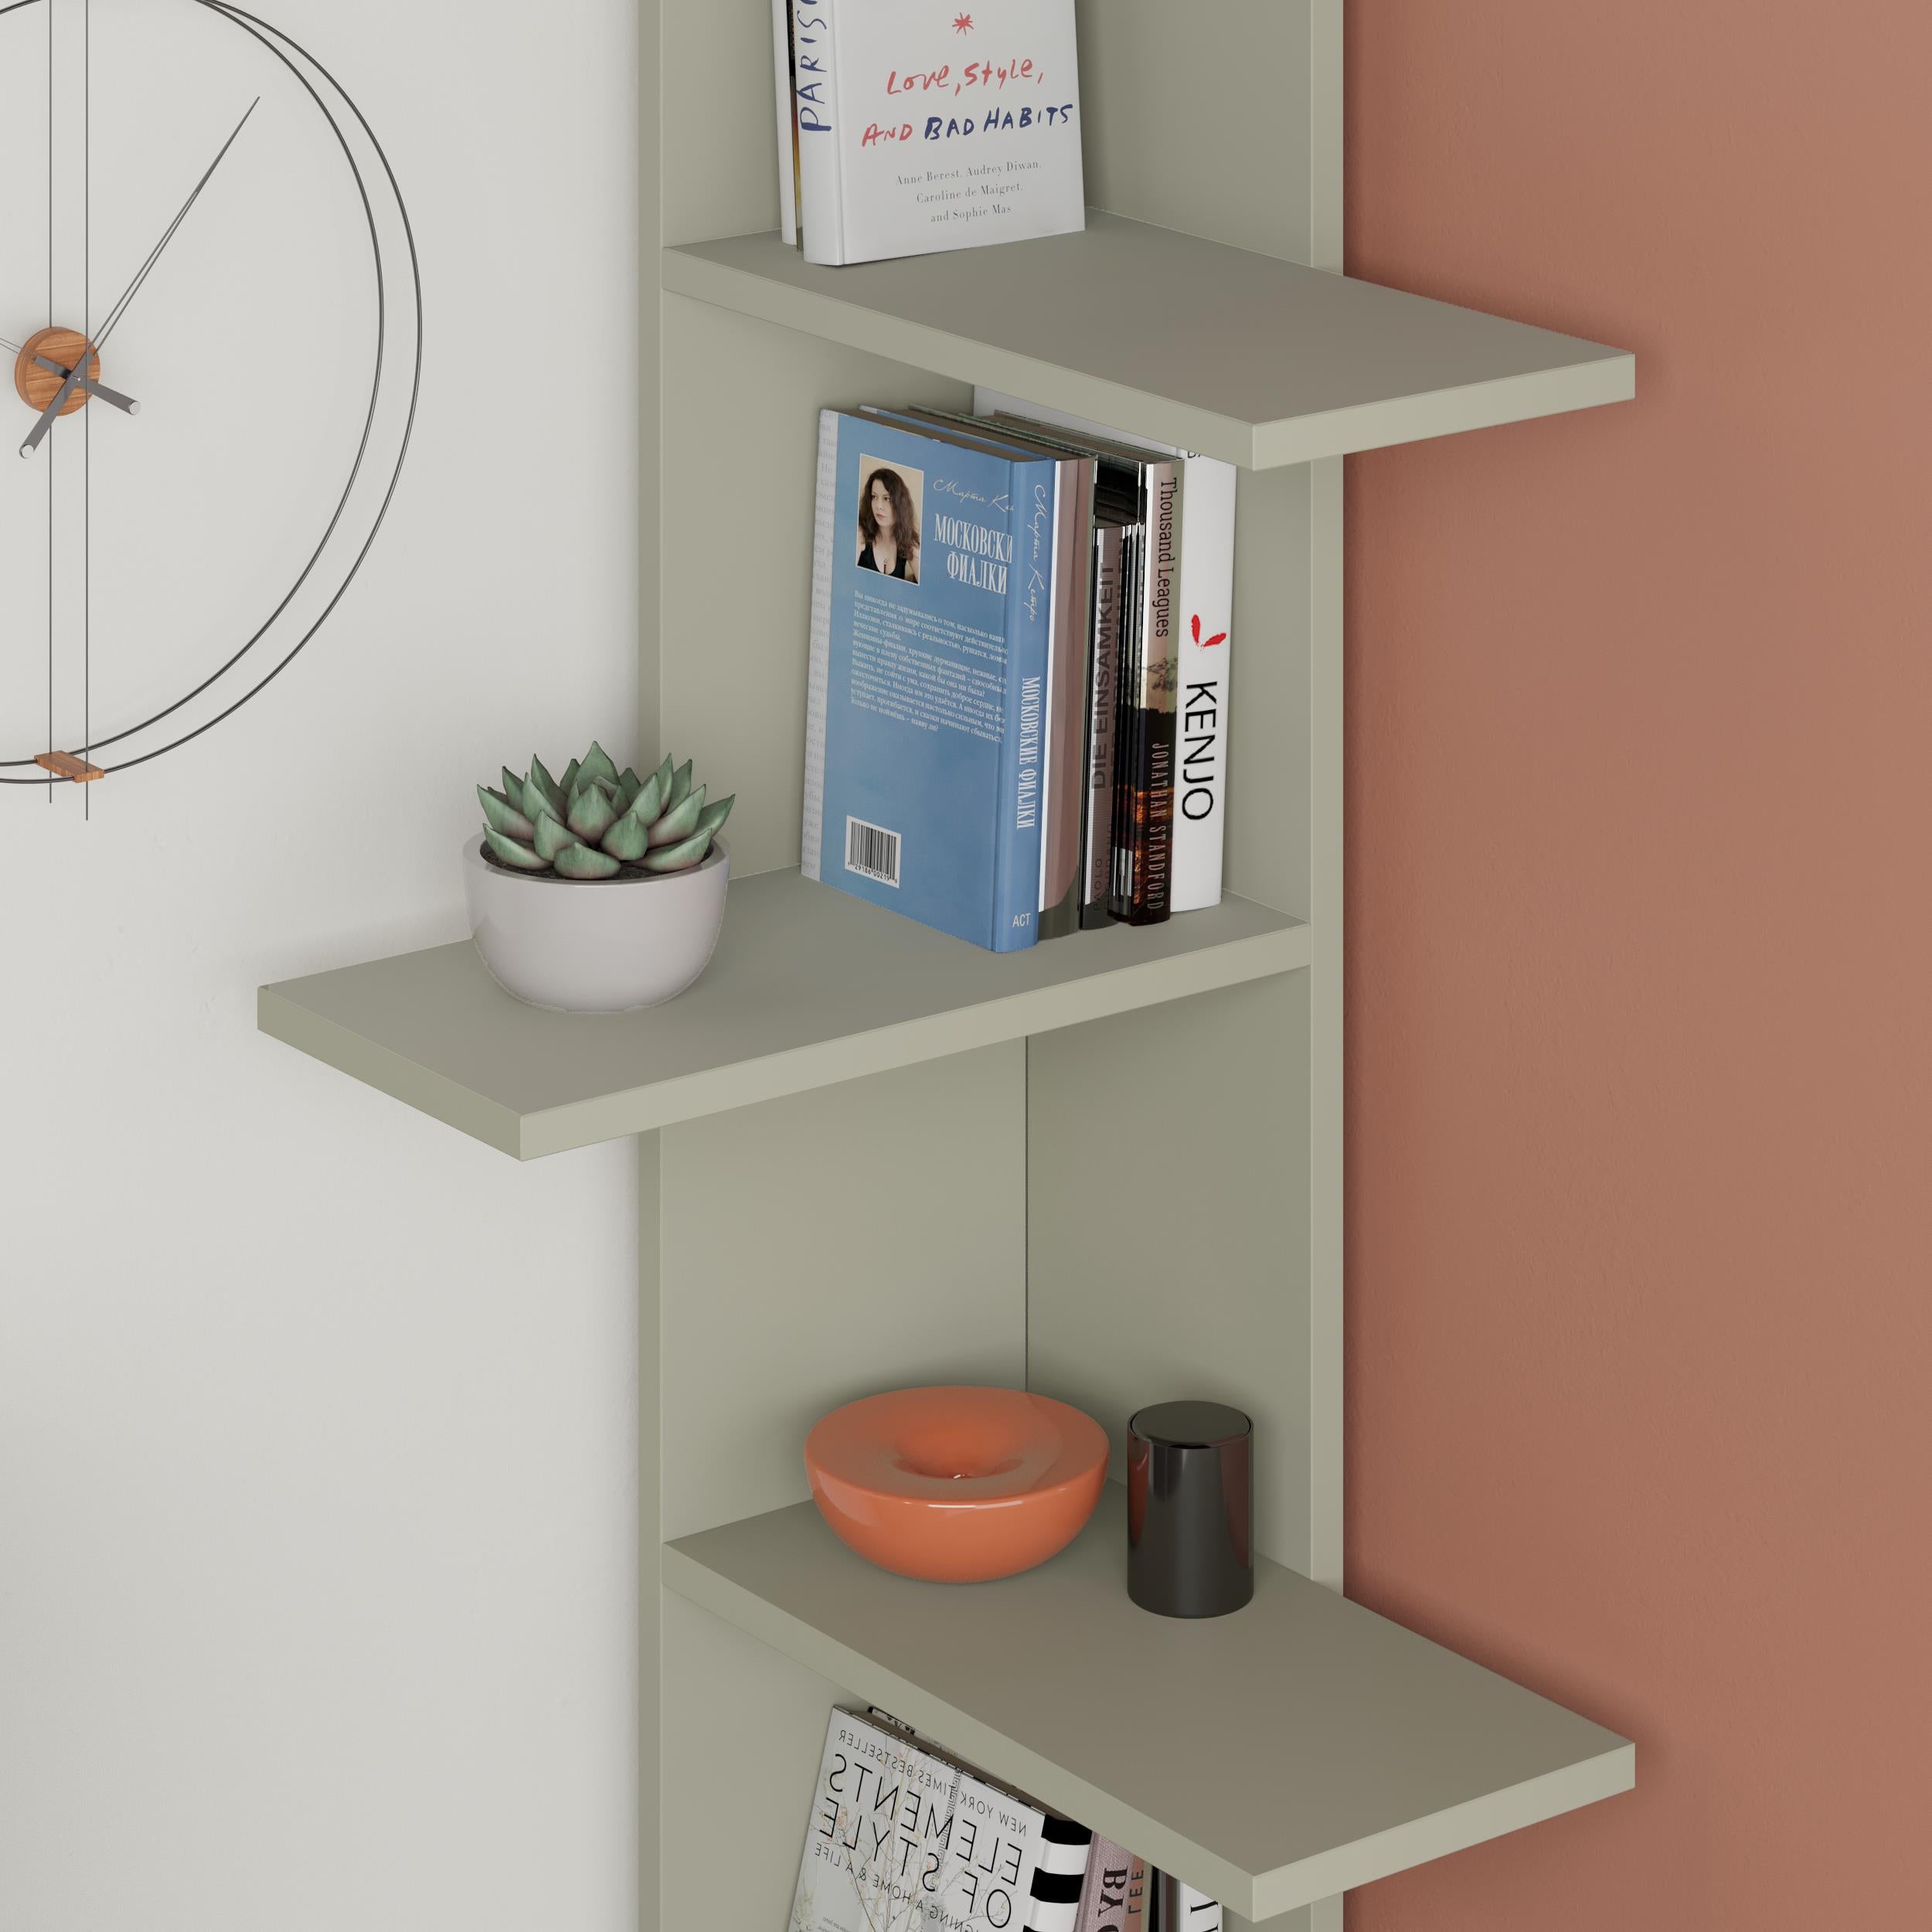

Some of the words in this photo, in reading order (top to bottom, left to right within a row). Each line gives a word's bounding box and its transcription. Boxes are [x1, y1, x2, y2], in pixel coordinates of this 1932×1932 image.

[862, 123, 914, 148] AND
[924, 117, 975, 141] BAD
[983, 104, 1073, 133] HABITS
[896, 175, 923, 185] Anne
[966, 164, 1003, 179] Audrey
[917, 190, 961, 204] Caroline
[964, 186, 978, 199] de
[930, 210, 950, 223] and
[952, 206, 989, 223] Sophie
[992, 204, 1012, 216] Mas
[1158, 478, 1177, 564] Thousand
[947, 551, 1009, 594] ФИАЛКИ
[1152, 568, 1174, 638] Leagues
[1096, 566, 1114, 733] EINSAMKEIT
[1019, 676, 1040, 764] МОСКОВСКИЕ
[1182, 682, 1216, 820] KENJO
[1092, 743, 1106, 789] DIE
[1149, 742, 1169, 819] JONATHAN
[1017, 769, 1036, 829] ФИАЛКИ
[1147, 826, 1167, 910] STANDFORD
